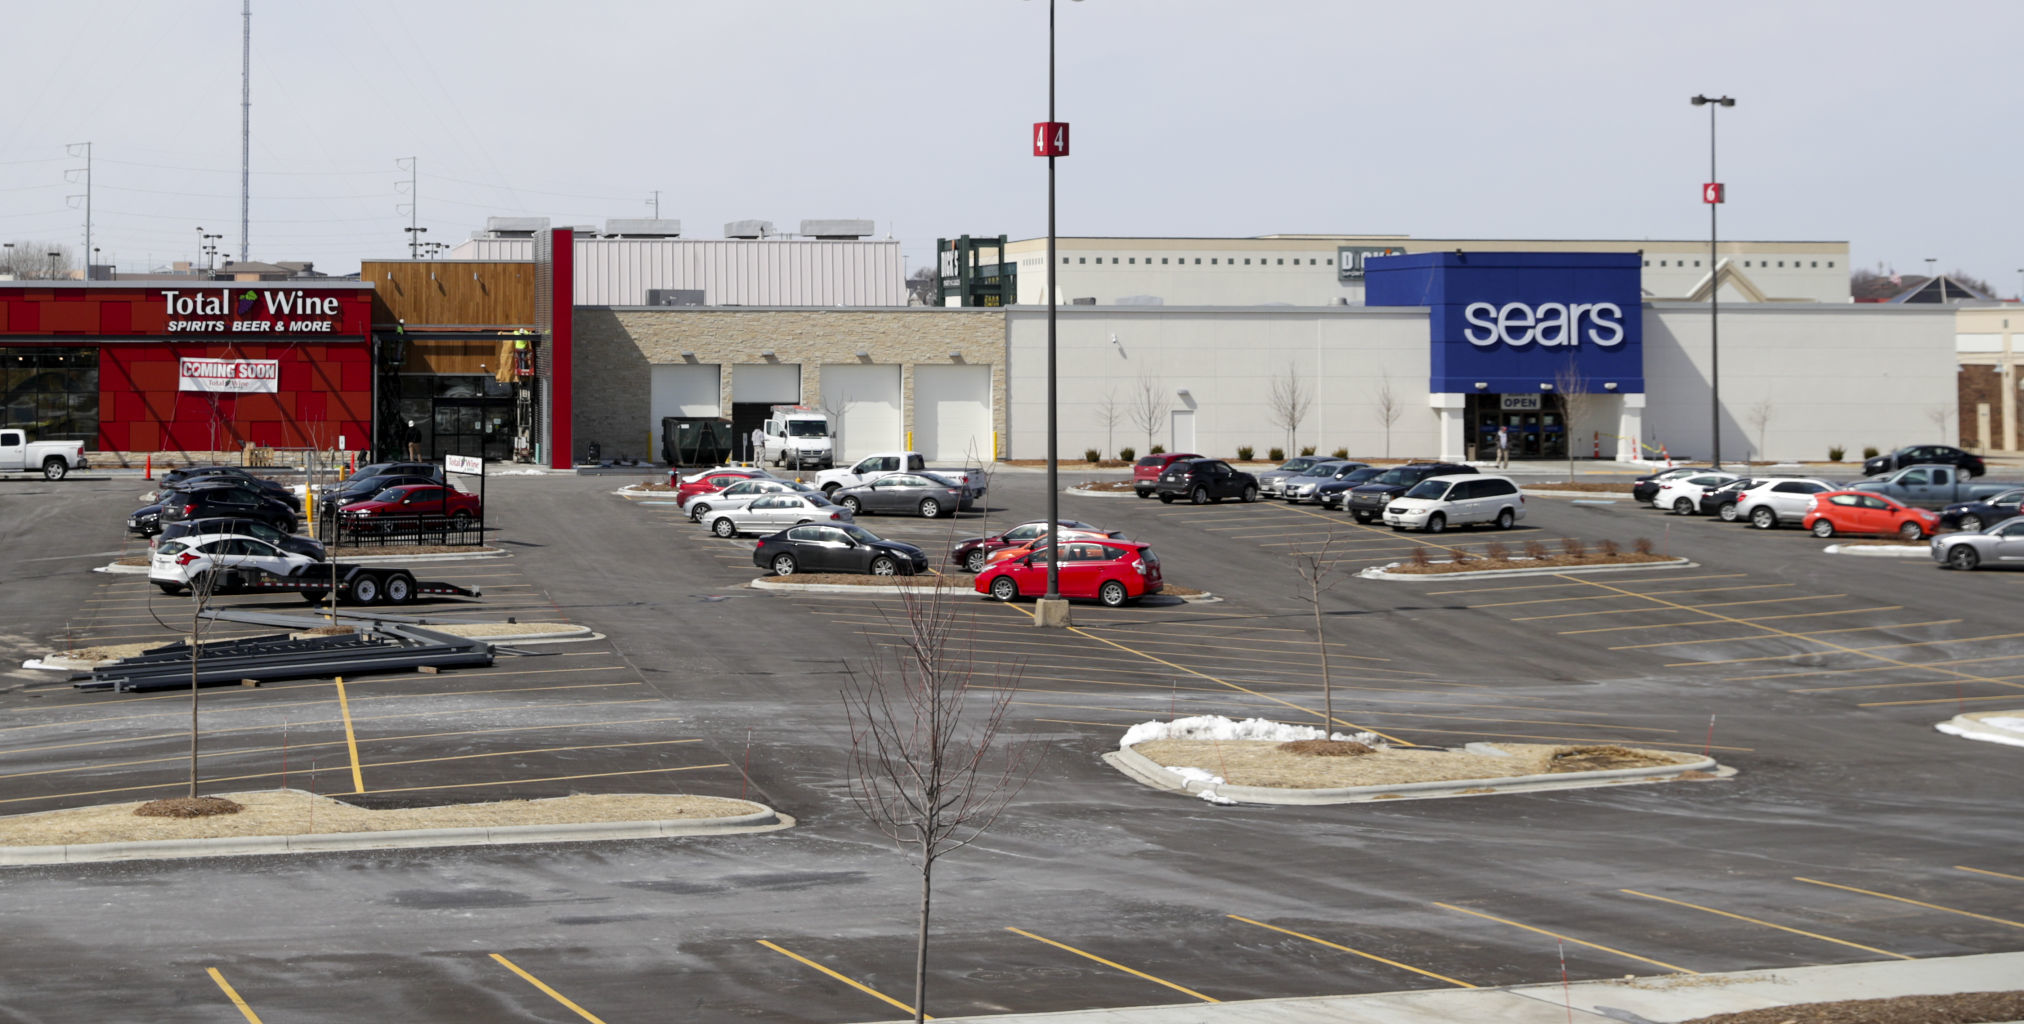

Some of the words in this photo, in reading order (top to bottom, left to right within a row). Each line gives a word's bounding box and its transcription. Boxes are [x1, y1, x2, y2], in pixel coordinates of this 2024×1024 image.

[1036, 126, 1044, 152] 4
[1053, 126, 1064, 152] 4
[1706, 185, 1716, 201] 6
[161, 289, 230, 316] Total
[264, 290, 339, 316] Wine
[168, 320, 225, 332] SPIRITS
[232, 320, 271, 332] BEER
[275, 320, 285, 332] &
[289, 320, 332, 332] MORE
[1464, 301, 1624, 347] sears
[183, 363, 236, 378] COMING
[238, 364, 275, 379] SOON
[1504, 398, 1537, 408] OPEN
